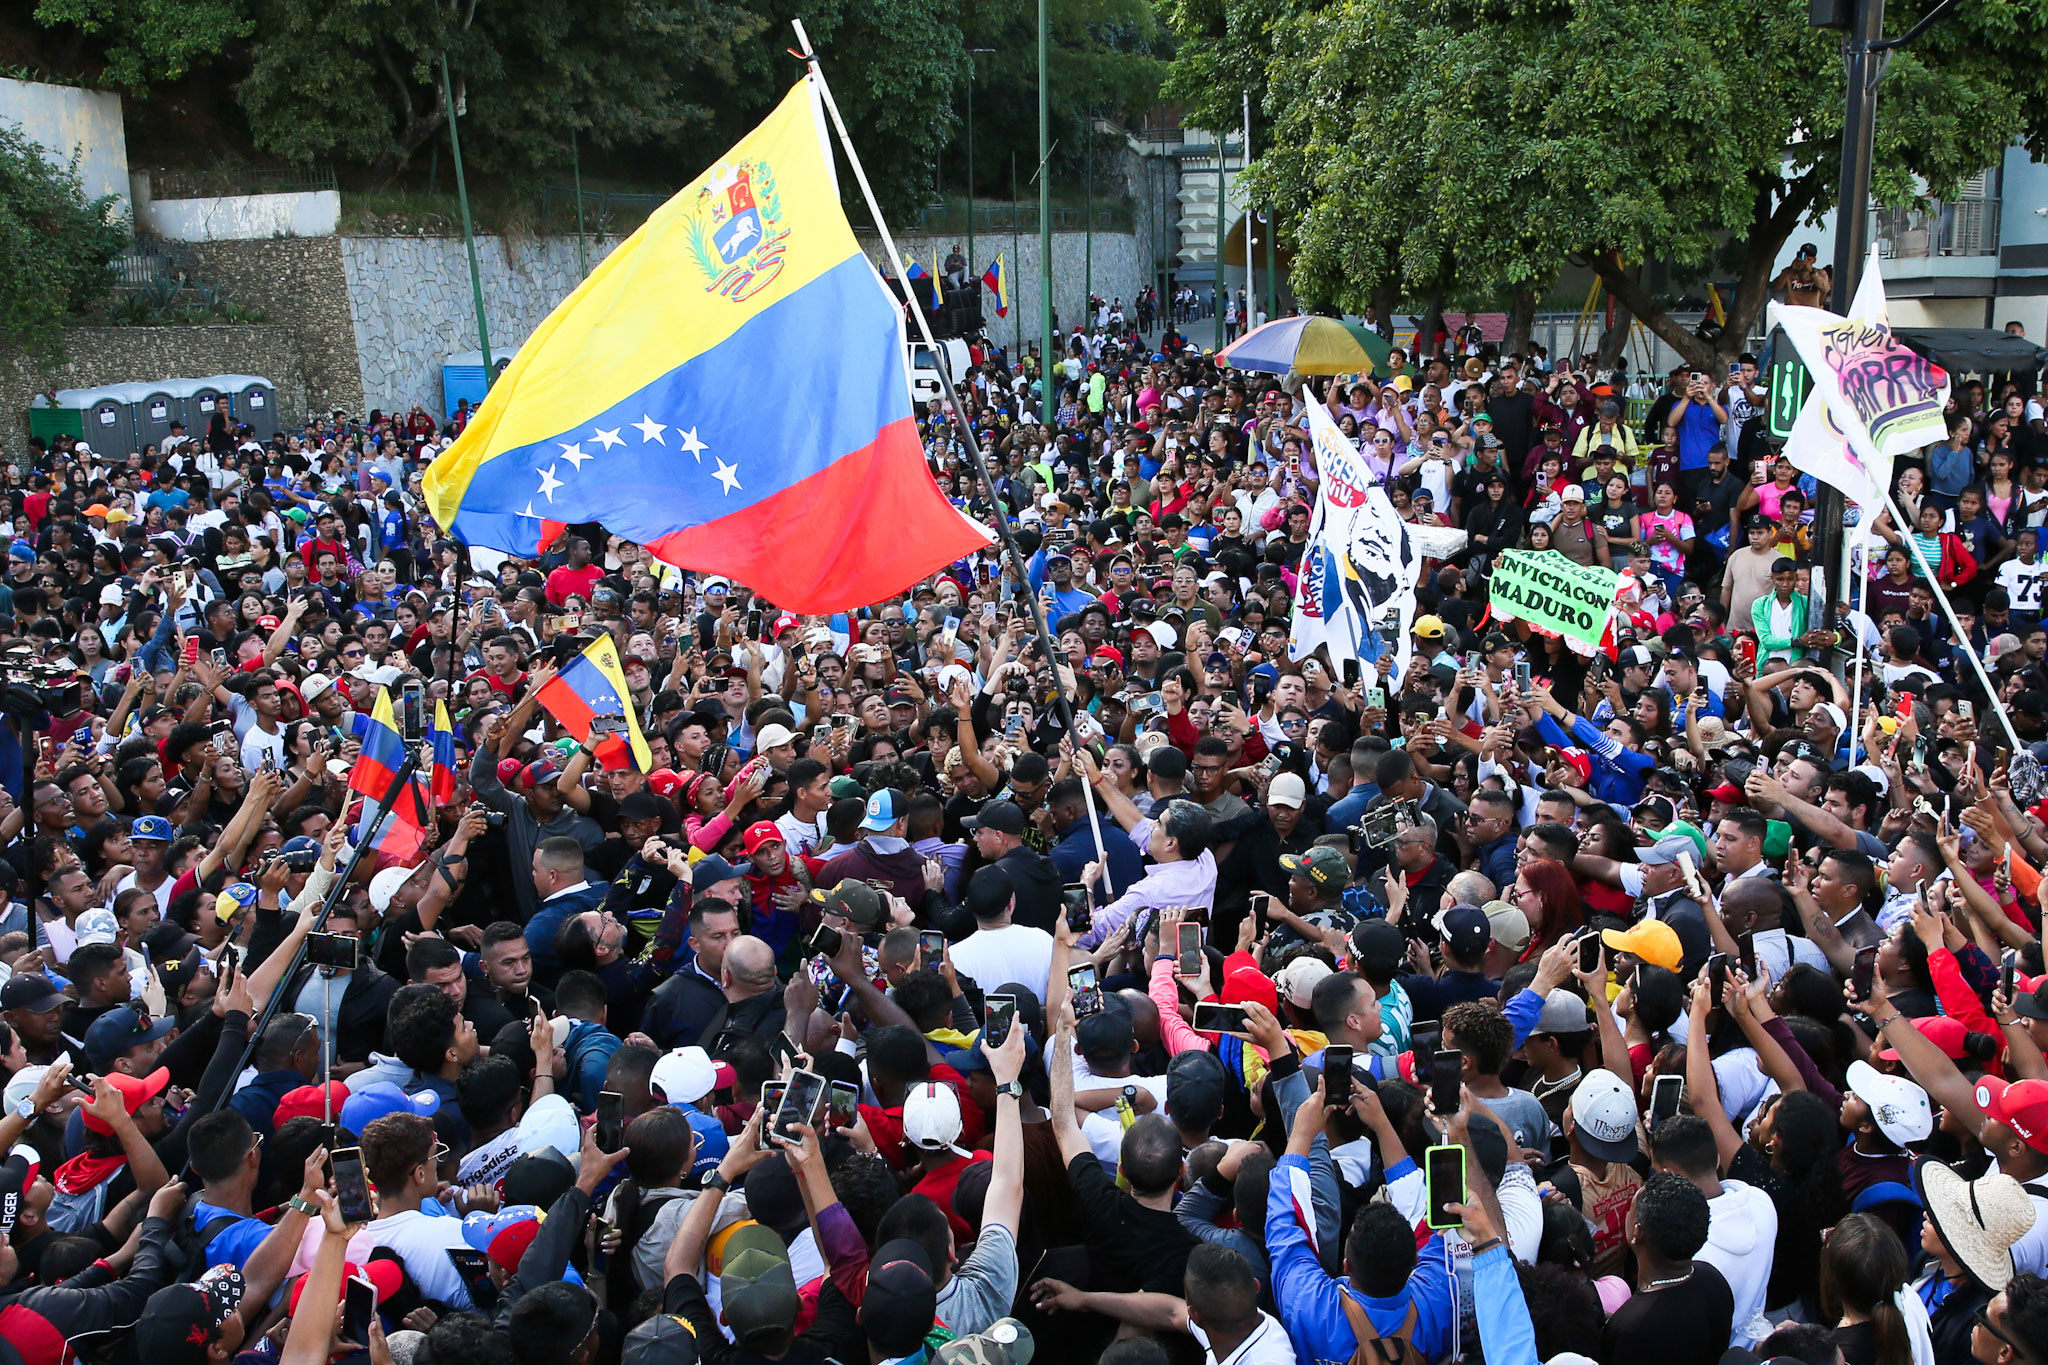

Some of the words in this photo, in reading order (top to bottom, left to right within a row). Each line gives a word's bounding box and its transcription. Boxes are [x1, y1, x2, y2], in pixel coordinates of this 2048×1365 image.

[1660, 463, 1670, 472] 10
[1491, 576, 1593, 630] MADURO
[2017, 574, 2044, 602] 73
[458, 1145, 518, 1188] Brigadista
